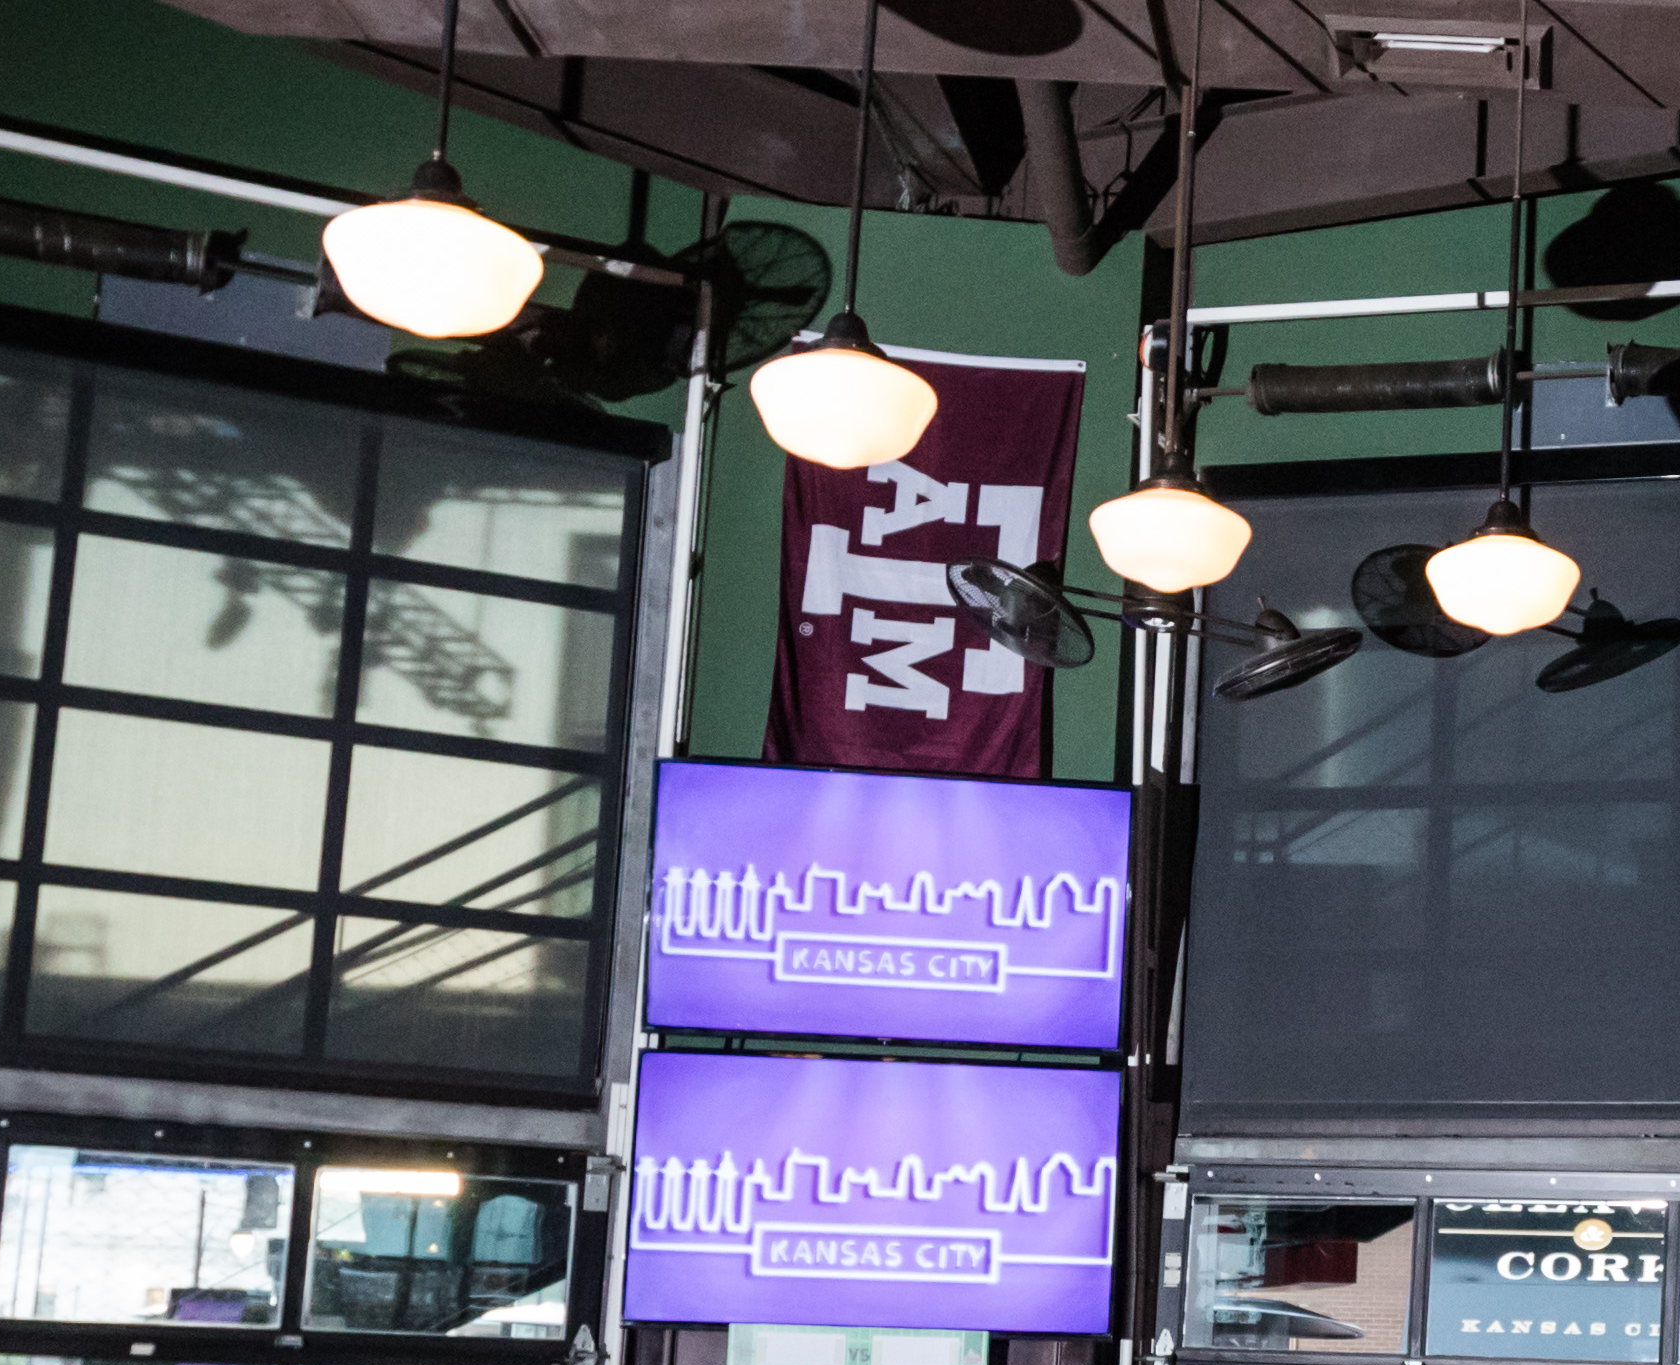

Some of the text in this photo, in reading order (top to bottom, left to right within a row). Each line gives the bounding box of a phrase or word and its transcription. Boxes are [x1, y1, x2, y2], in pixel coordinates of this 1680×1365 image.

[791, 946, 994, 980] KANSAS CITY
[1579, 1225, 1604, 1243] &
[769, 1239, 987, 1272] KANSAS CITY
[1459, 1318, 1607, 1337] KANSAS
[848, 1347, 871, 1363] VS
